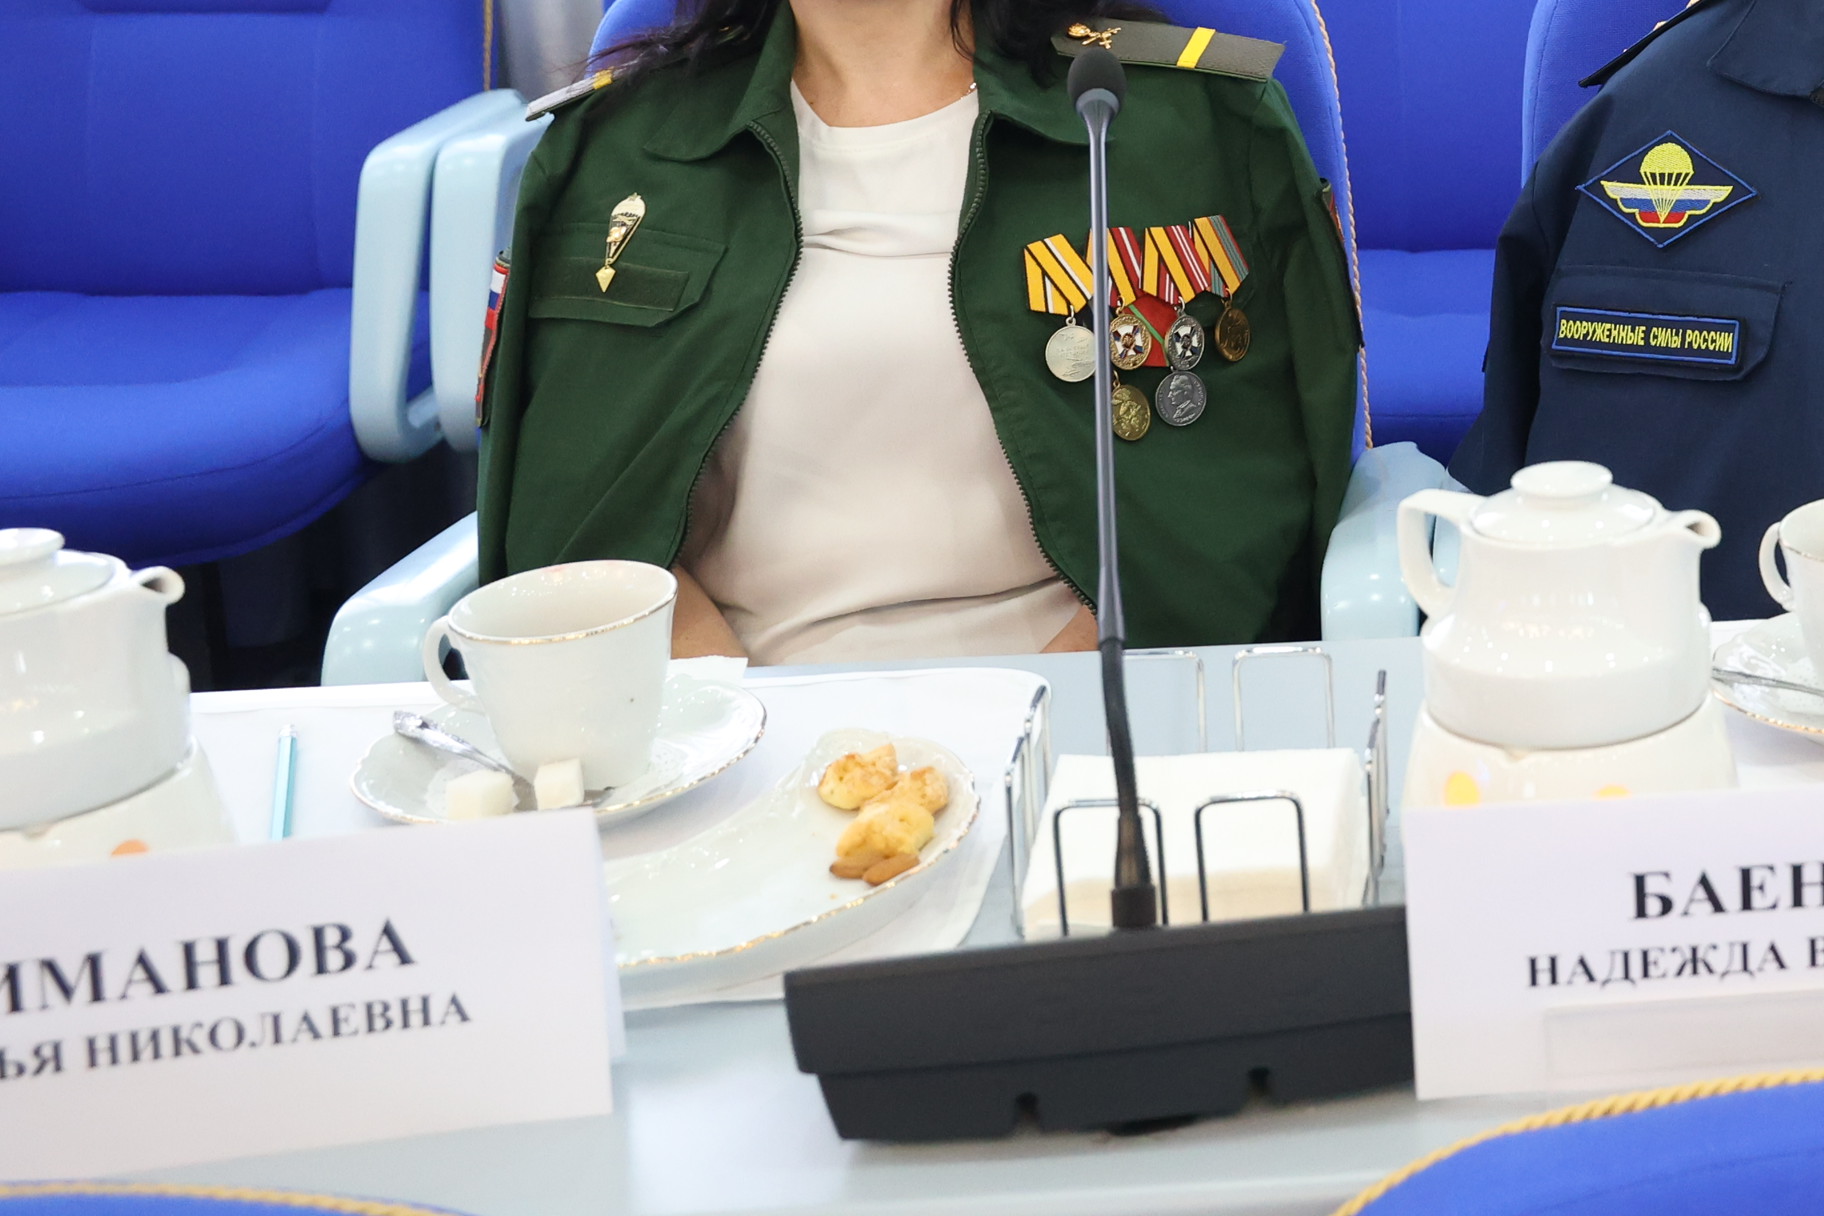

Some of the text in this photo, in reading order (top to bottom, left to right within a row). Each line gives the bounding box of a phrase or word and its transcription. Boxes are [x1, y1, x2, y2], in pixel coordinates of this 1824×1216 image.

[1558, 319, 1734, 353] ВООРУЖЕННЫЕ СИЛЫ РОССИИ
[1526, 938, 1789, 989] НАДЕЖДА
[86, 991, 472, 1070] НИКОЛАЕВНА
